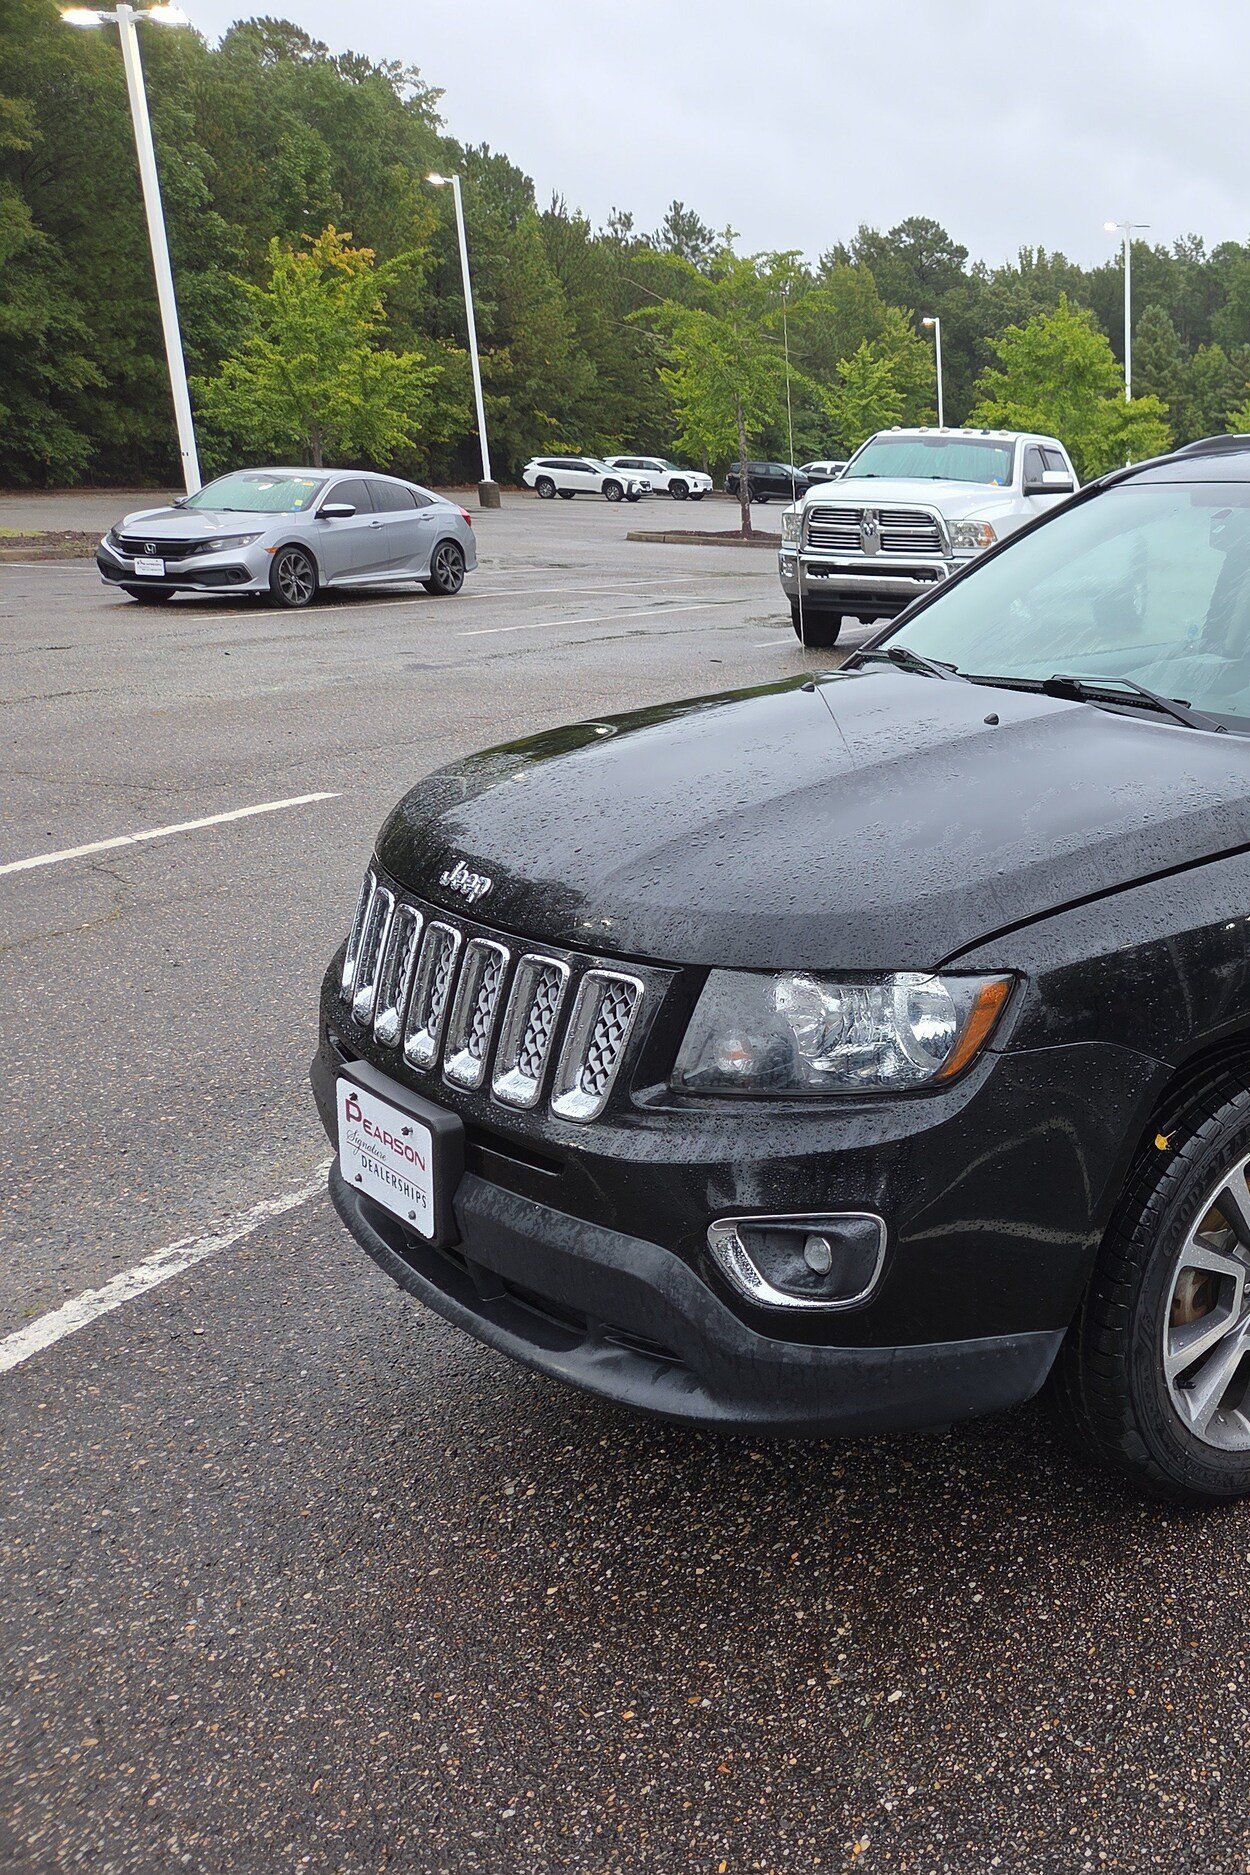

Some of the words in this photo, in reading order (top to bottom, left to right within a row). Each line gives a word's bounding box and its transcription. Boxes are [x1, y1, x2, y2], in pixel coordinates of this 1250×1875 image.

[439, 860, 493, 904] Jeep
[345, 1098, 426, 1172] PEARSON
[346, 1129, 387, 1161] Signature
[361, 1155, 427, 1209] DEALERSHIPS
